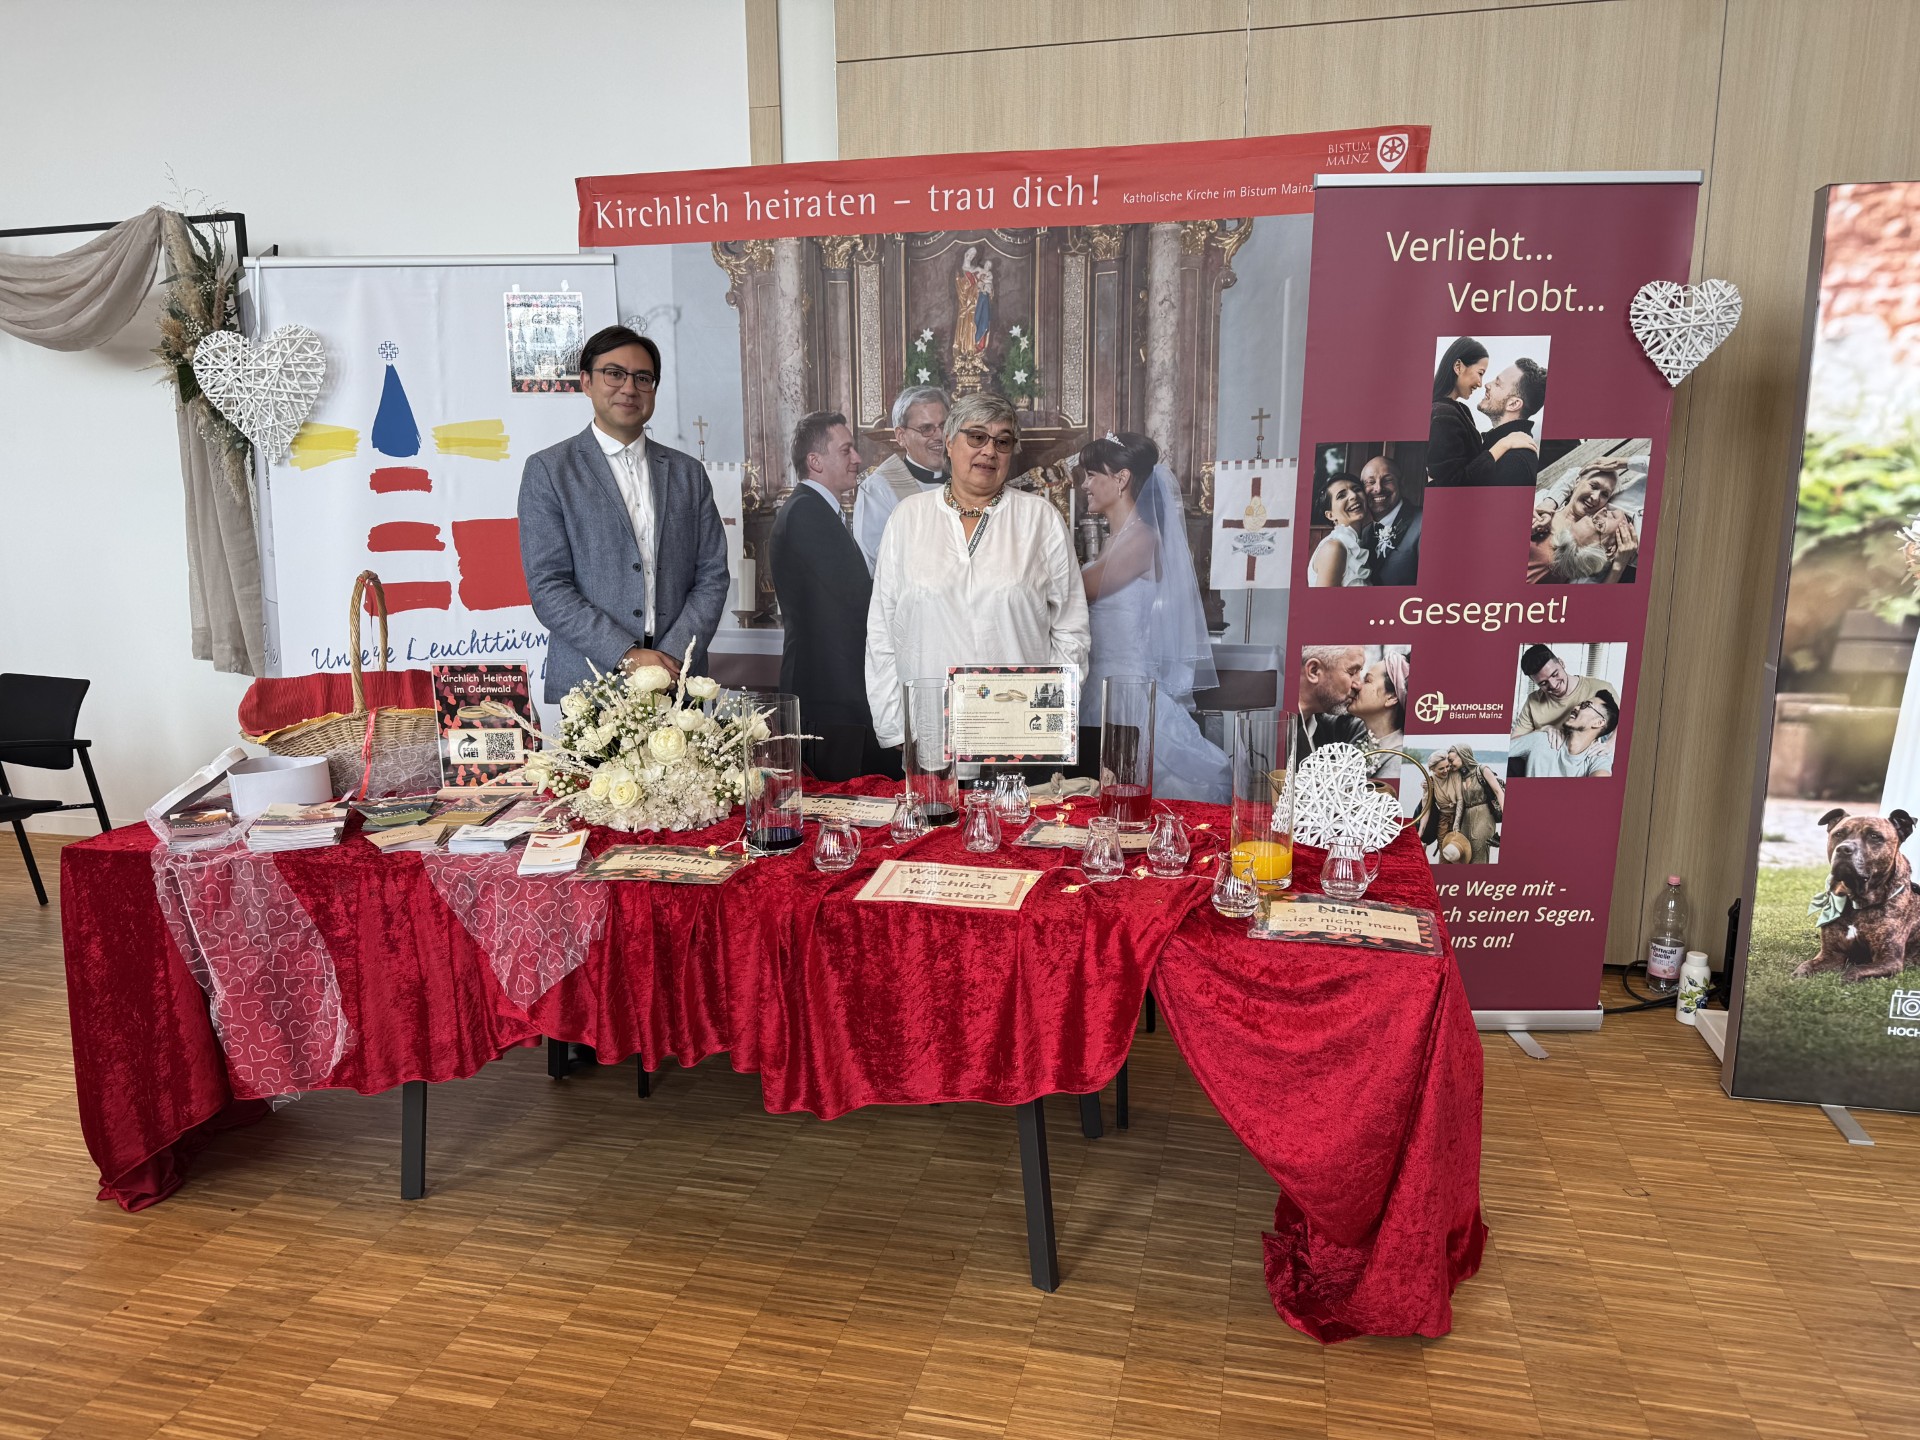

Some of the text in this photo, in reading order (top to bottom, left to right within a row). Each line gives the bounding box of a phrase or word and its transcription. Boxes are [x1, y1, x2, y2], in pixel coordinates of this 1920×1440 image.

[1328, 141, 1371, 154] BISTUM
[1325, 153, 1369, 166] MAINZ
[1122, 182, 1314, 204] Katholische Kirche im Bistum Mainz
[594, 193, 729, 229] Kirchlich
[743, 189, 876, 221] heiraten
[928, 184, 994, 212] trau
[1012, 174, 1100, 209] dich!
[1386, 228, 1553, 262] Verliebt...
[1447, 279, 1605, 313] Verlobt...
[1369, 596, 1568, 632] ...Gesegnet!
[440, 674, 523, 683] Kirchlich Heiraten
[468, 685, 511, 693] Odenwald
[1450, 703, 1504, 711] KATHOLISCH
[846, 800, 884, 808] aber
[629, 855, 712, 866] Vielleicht
[908, 867, 969, 878] Wollen
[911, 878, 992, 890] kirchlich
[1466, 880, 1517, 901] Wege
[1522, 880, 1556, 896] mit
[902, 887, 997, 900] heiraten?
[1318, 904, 1369, 917] Nein
[1466, 906, 1530, 922] seinen
[1534, 906, 1595, 926] Segen.
[1320, 917, 1363, 925] nicht
[1368, 921, 1407, 932] mein
[1326, 924, 1362, 935] Ding
[1483, 933, 1515, 948] an!
